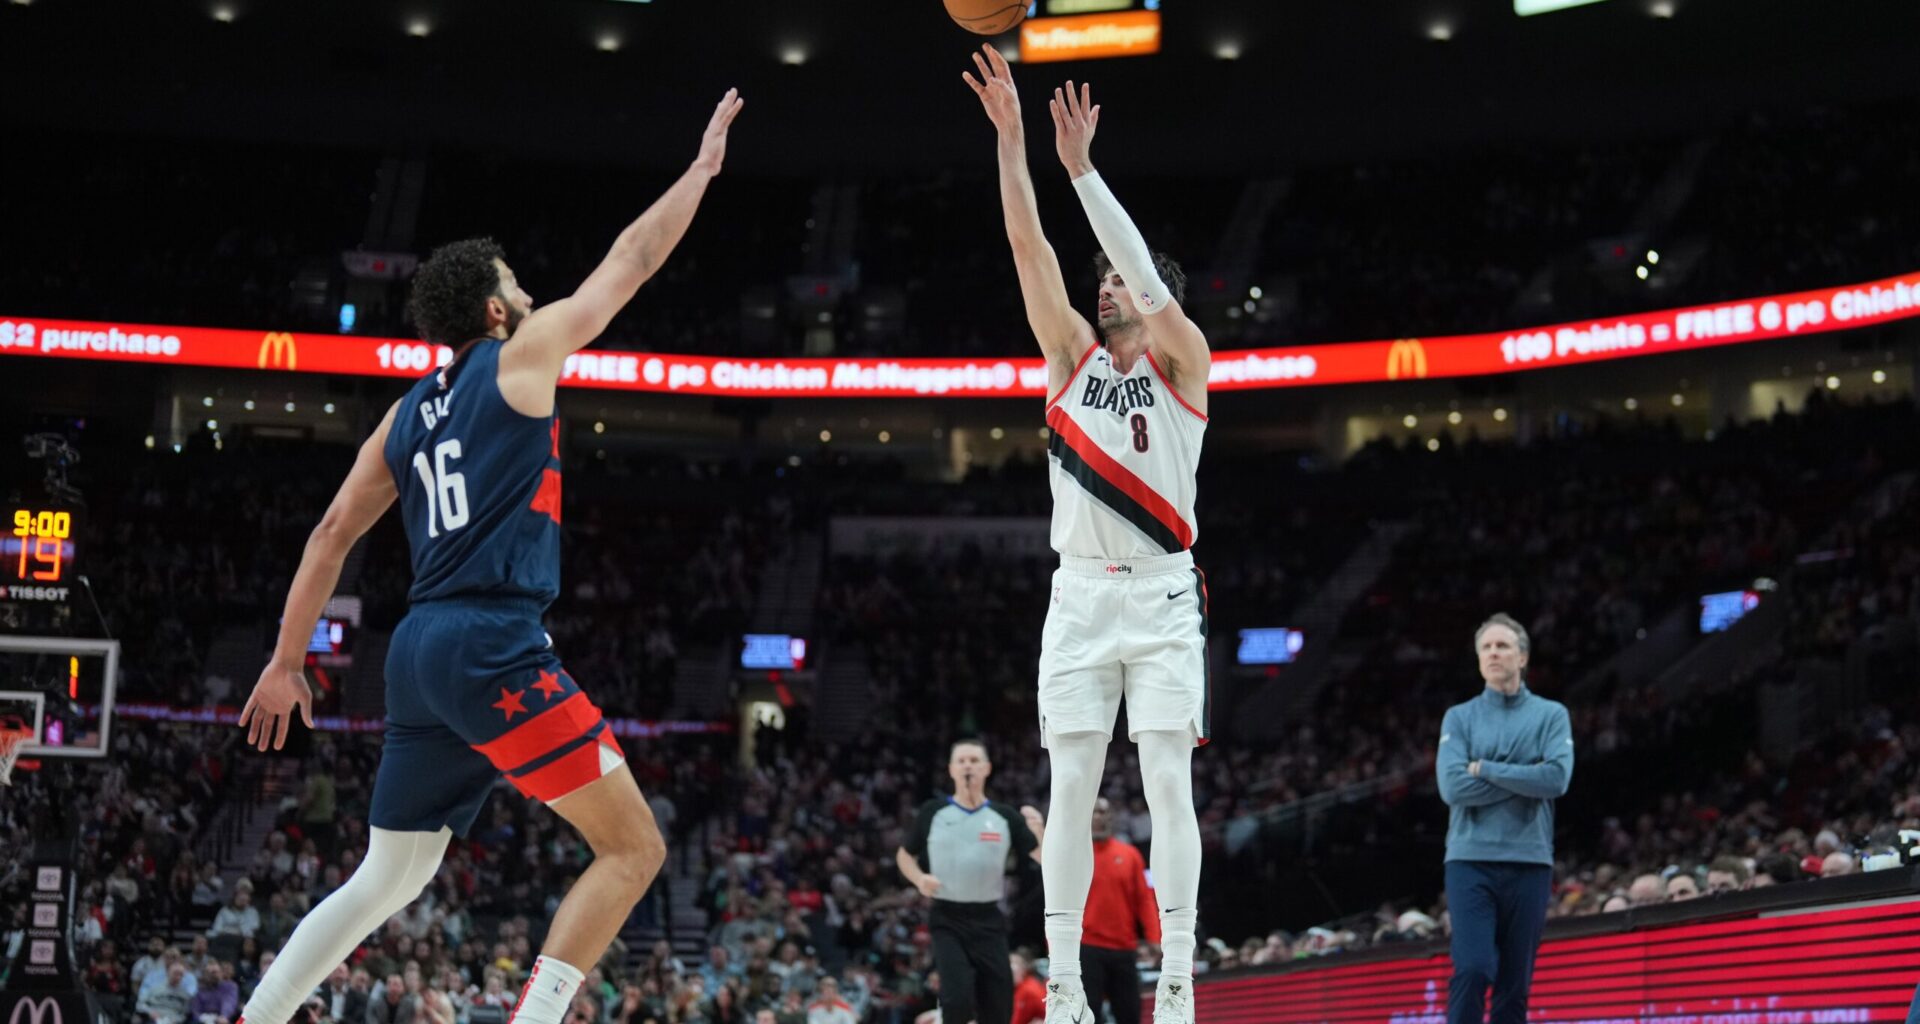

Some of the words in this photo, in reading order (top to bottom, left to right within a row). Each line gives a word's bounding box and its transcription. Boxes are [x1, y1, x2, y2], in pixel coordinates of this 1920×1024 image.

[41, 328, 180, 355] purchase
[1500, 332, 1552, 363] 100
[1555, 322, 1646, 356] Points
[1676, 304, 1755, 341] FREE
[1759, 302, 1782, 330] 6
[377, 344, 431, 370] 100
[564, 353, 638, 382] FREE
[643, 358, 664, 384] 6
[711, 362, 827, 389] Chicken
[1130, 413, 1149, 454] 8
[412, 438, 470, 539] 16
[13, 509, 71, 539] 9:00
[17, 535, 63, 581] 19
[1106, 564, 1132, 574] ripcity
[9, 586, 69, 601] TISSOT
